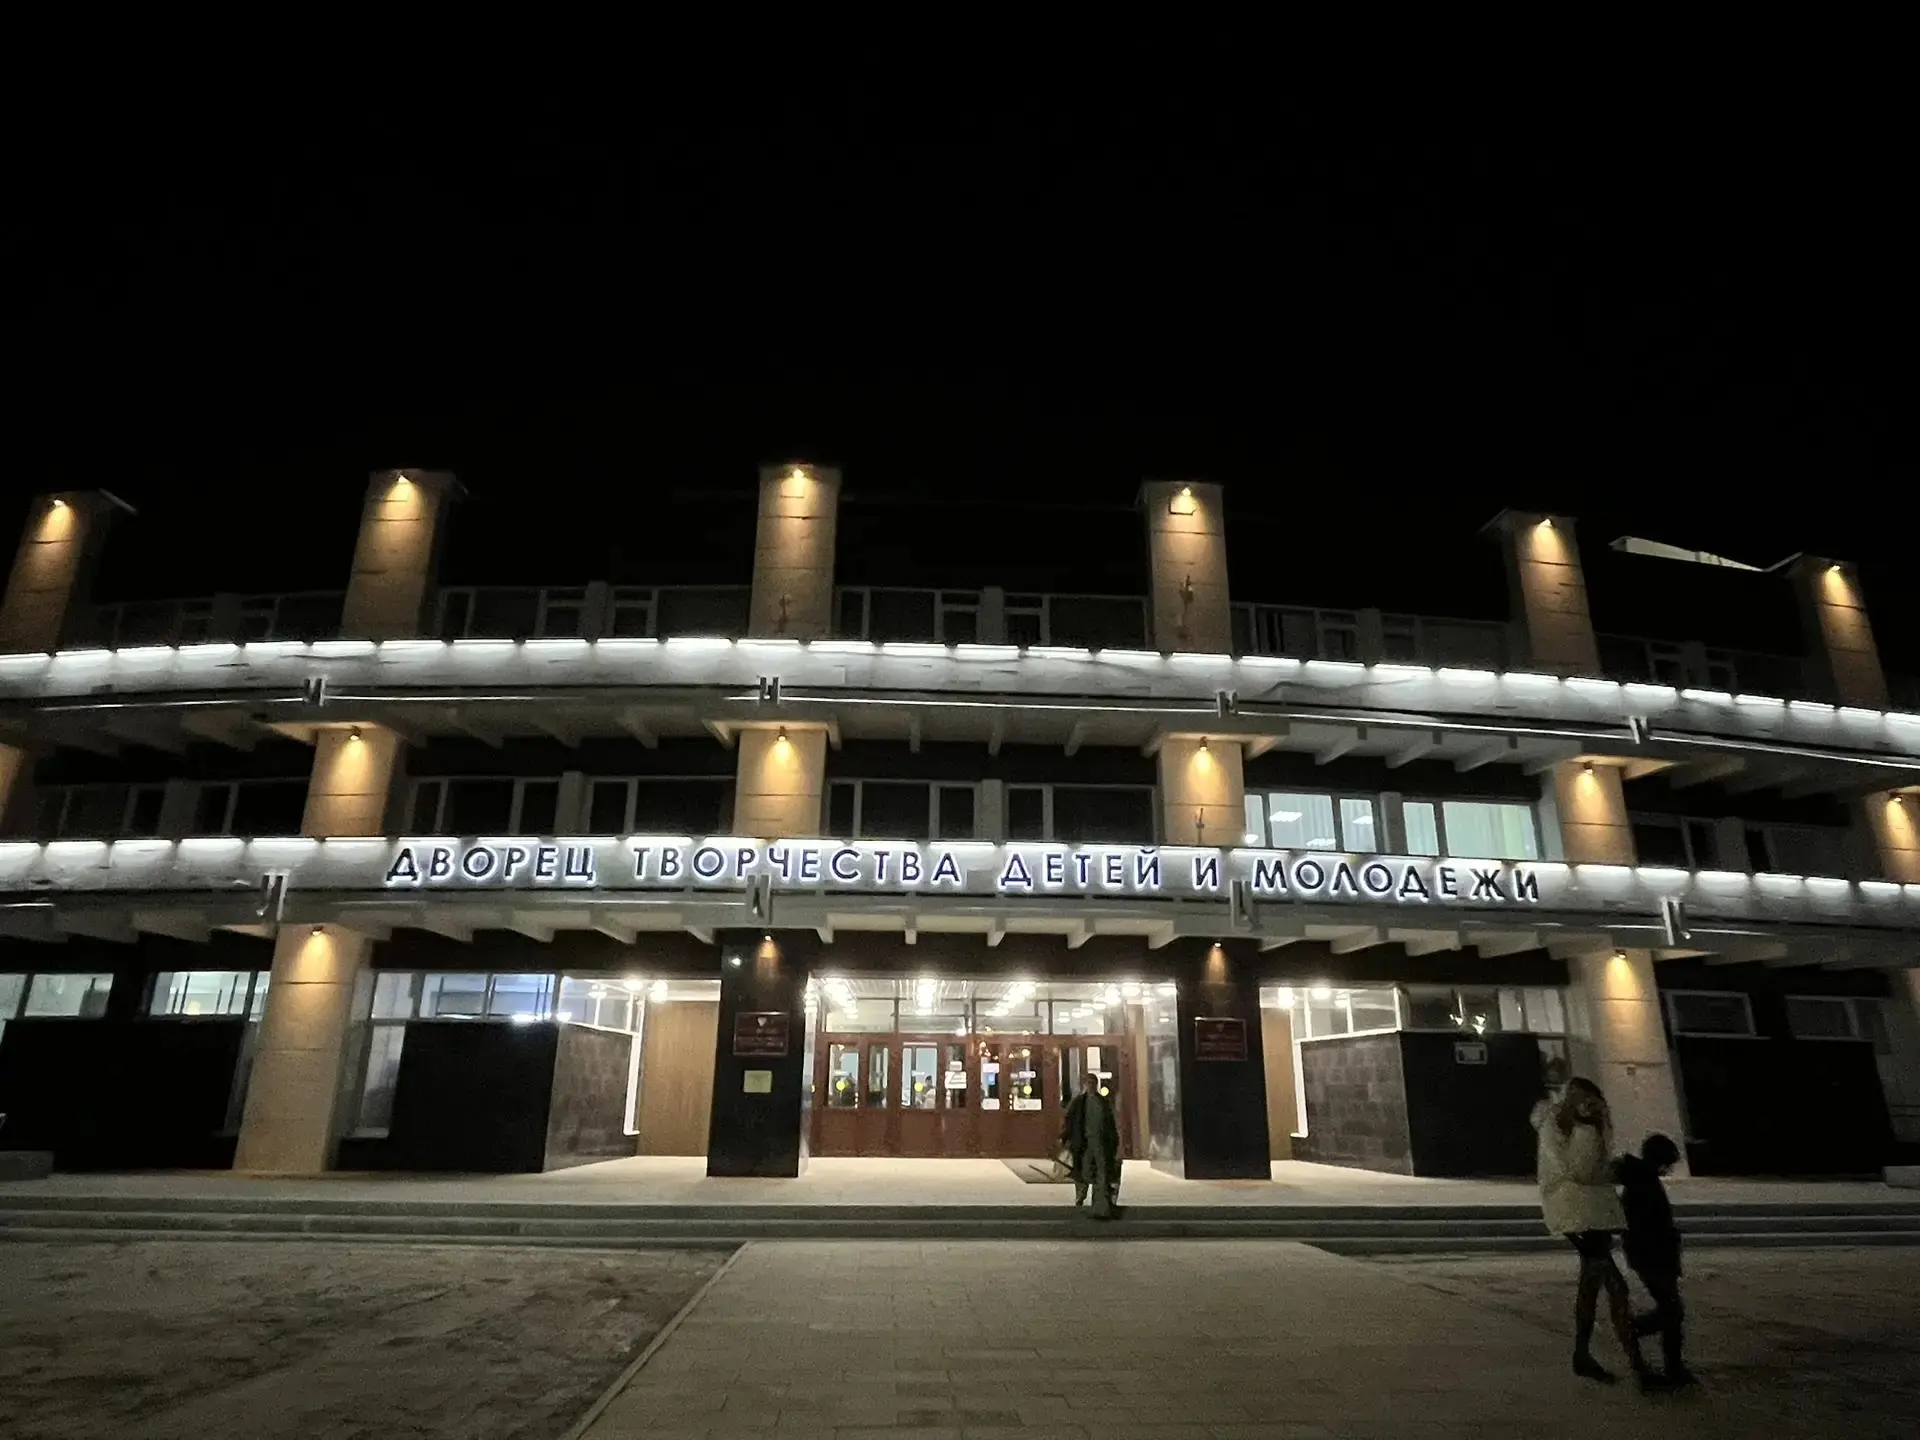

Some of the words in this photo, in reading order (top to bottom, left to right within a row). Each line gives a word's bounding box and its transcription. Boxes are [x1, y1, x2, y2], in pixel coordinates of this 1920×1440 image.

[386, 847, 596, 882] ДВОРЕЦ
[633, 846, 960, 882] ТВОРЧЕСТВА
[1000, 846, 1160, 887] ДЕТЕЙ
[1194, 856, 1218, 888] И
[1253, 859, 1539, 902] МОЛОДЕЖИ
